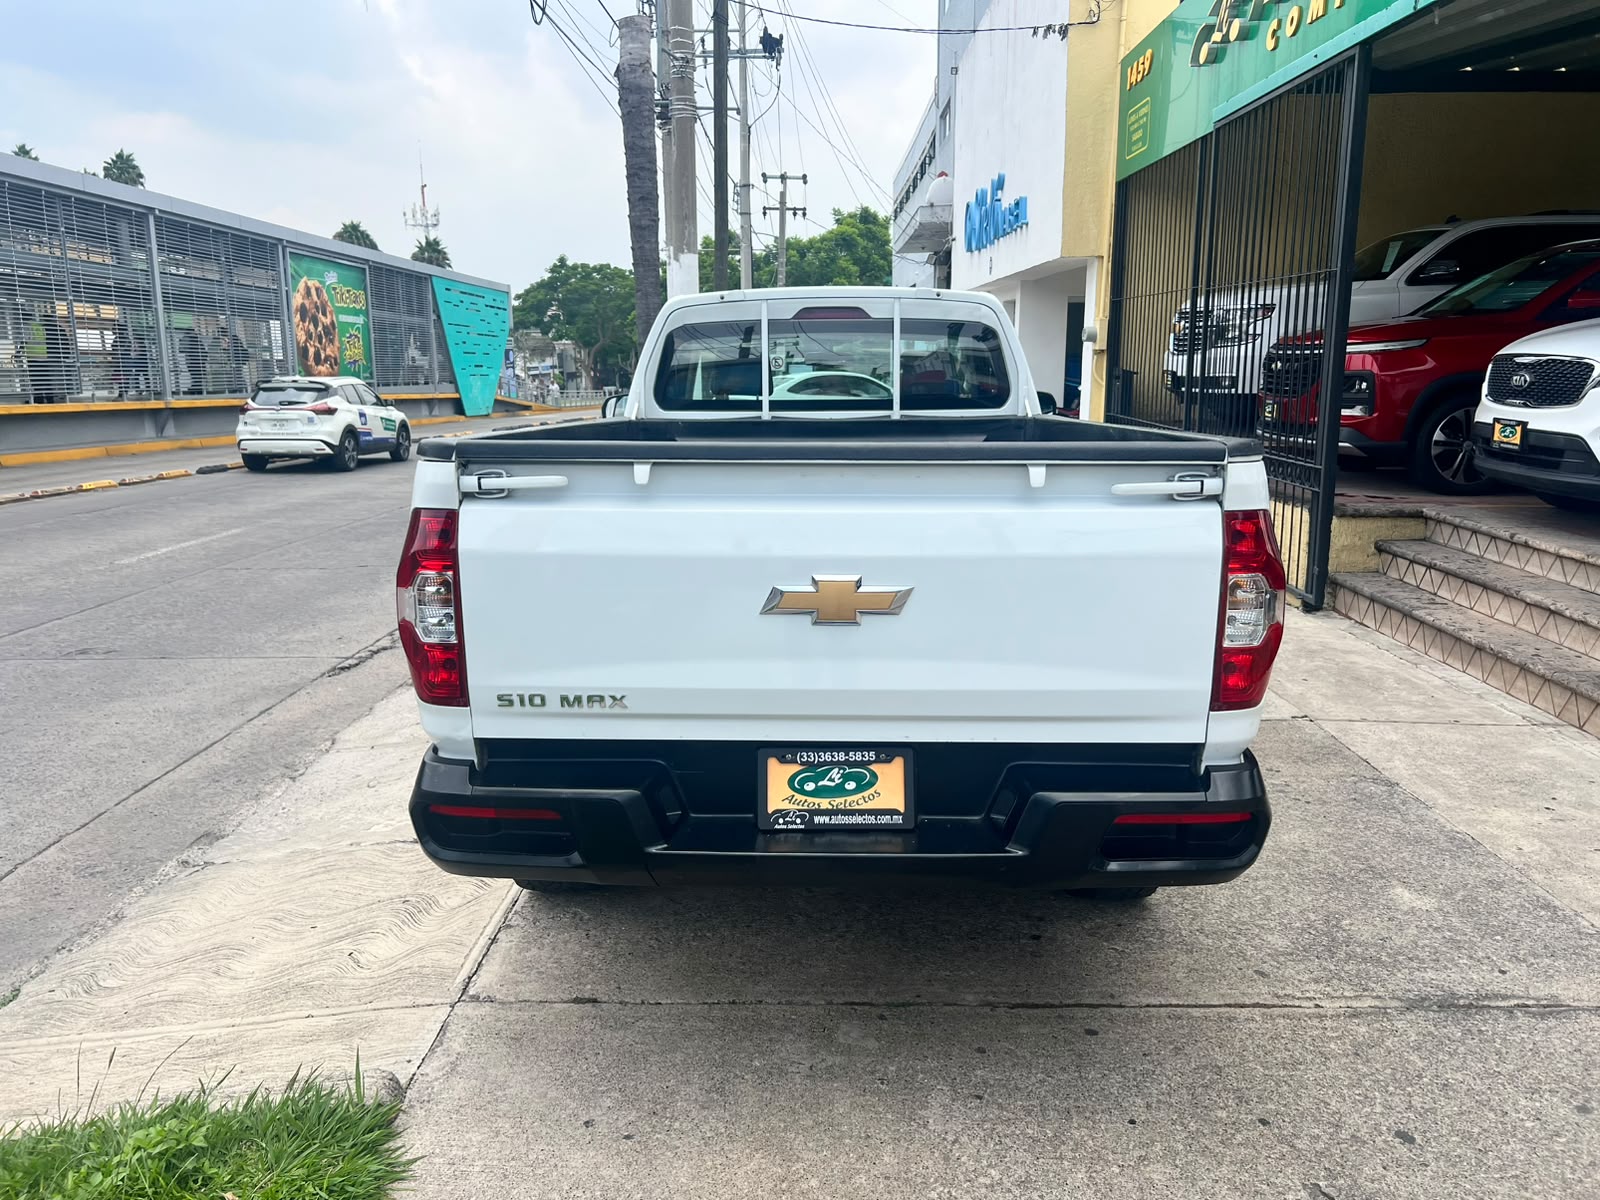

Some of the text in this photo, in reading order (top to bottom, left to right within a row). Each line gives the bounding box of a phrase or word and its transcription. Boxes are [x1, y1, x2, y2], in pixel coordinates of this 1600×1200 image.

[1127, 49, 1154, 91] 1459
[496, 693, 629, 709] S10 MAX
[796, 751, 876, 764] (33)3638-5835
[781, 788, 881, 810] Autos Selectos
[813, 813, 904, 825] www.autosselectos.com.mx
